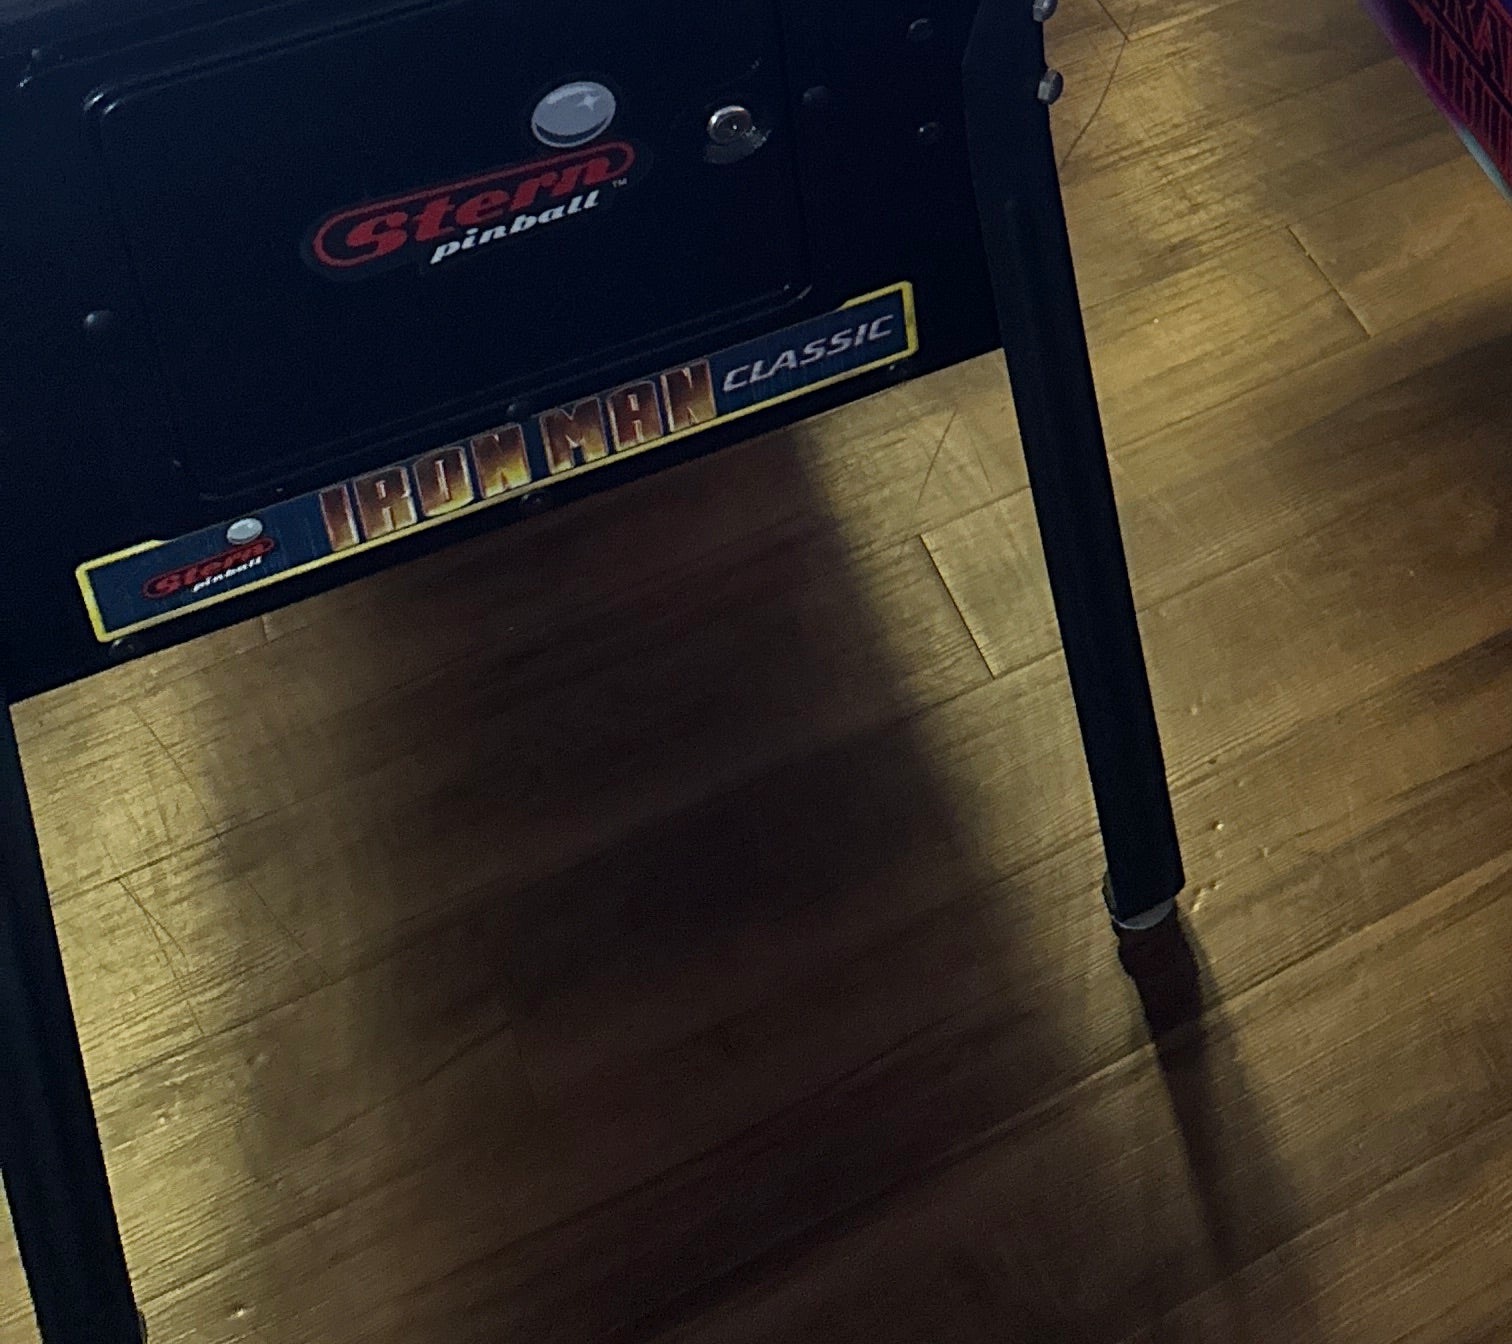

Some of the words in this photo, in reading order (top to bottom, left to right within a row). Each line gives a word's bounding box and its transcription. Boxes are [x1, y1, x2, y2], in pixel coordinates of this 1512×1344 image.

[346, 158, 609, 254] Stern
[430, 189, 600, 264] pinball
[318, 423, 532, 552] IRON
[539, 358, 718, 474] MAN
[722, 313, 895, 393] CLASSIC
[151, 540, 266, 593] Stern
[192, 555, 263, 593] pinball
